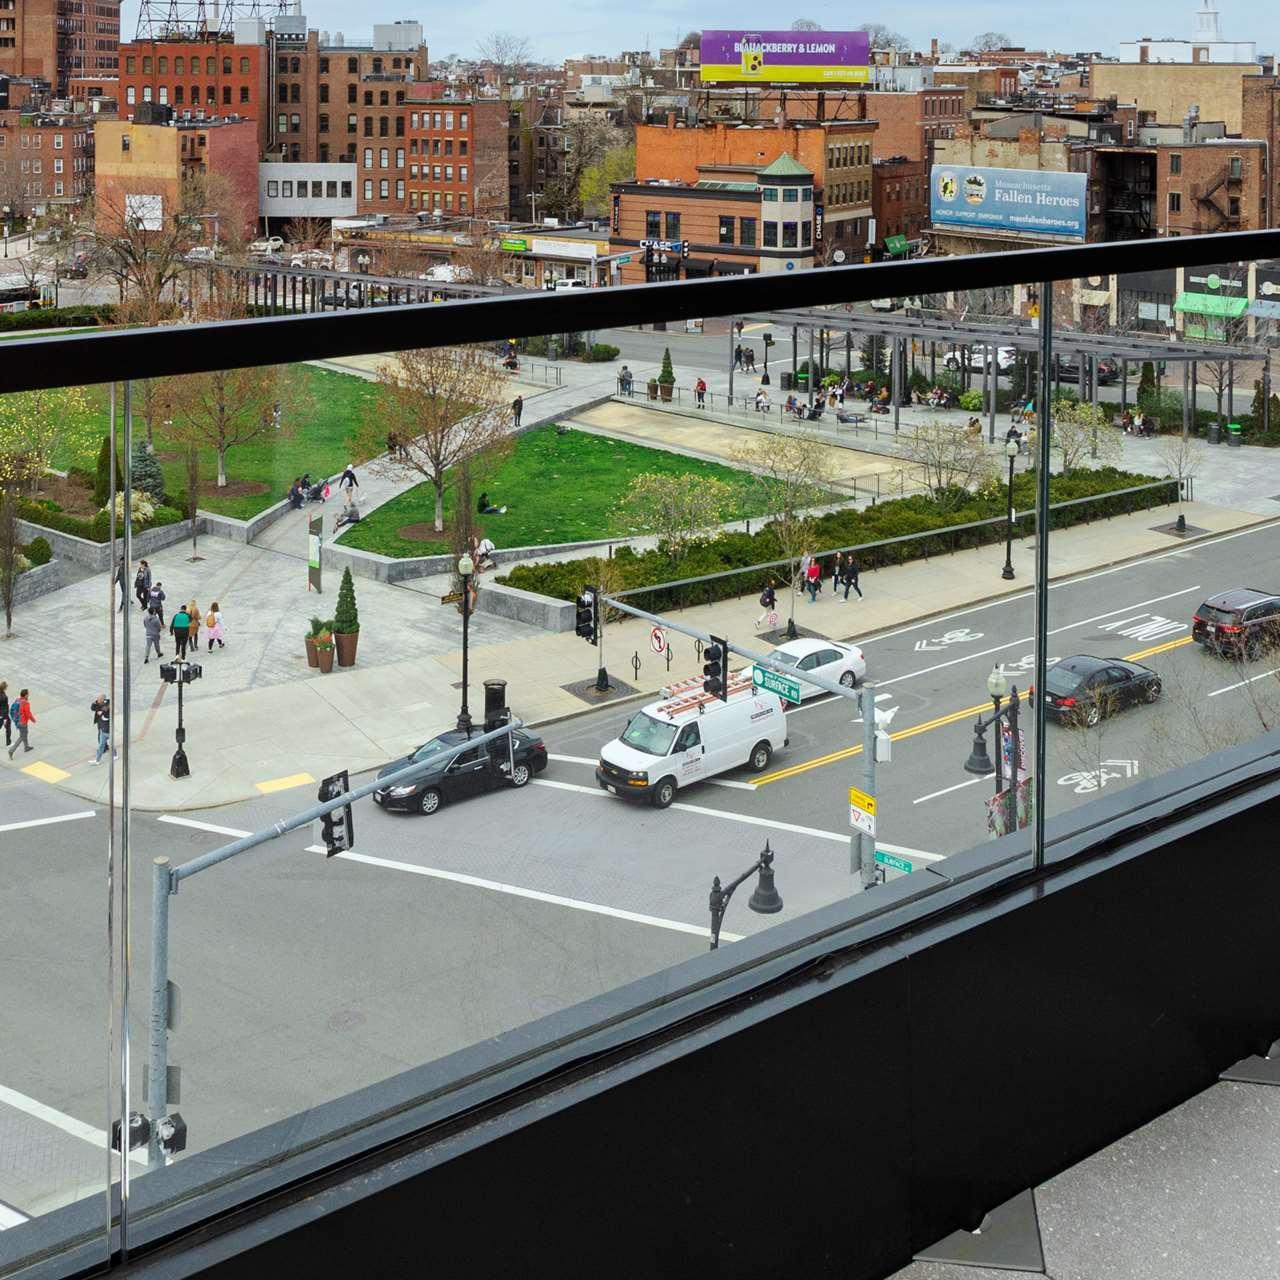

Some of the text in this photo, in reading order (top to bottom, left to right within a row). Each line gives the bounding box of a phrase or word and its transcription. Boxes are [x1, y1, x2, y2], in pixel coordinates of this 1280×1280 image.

[798, 43, 806, 53] &
[806, 43, 836, 53] LEMON
[994, 189, 1080, 207] Fallen Heroes
[1096, 613, 1189, 641] ONLY
[764, 677, 791, 696] SURFACE
